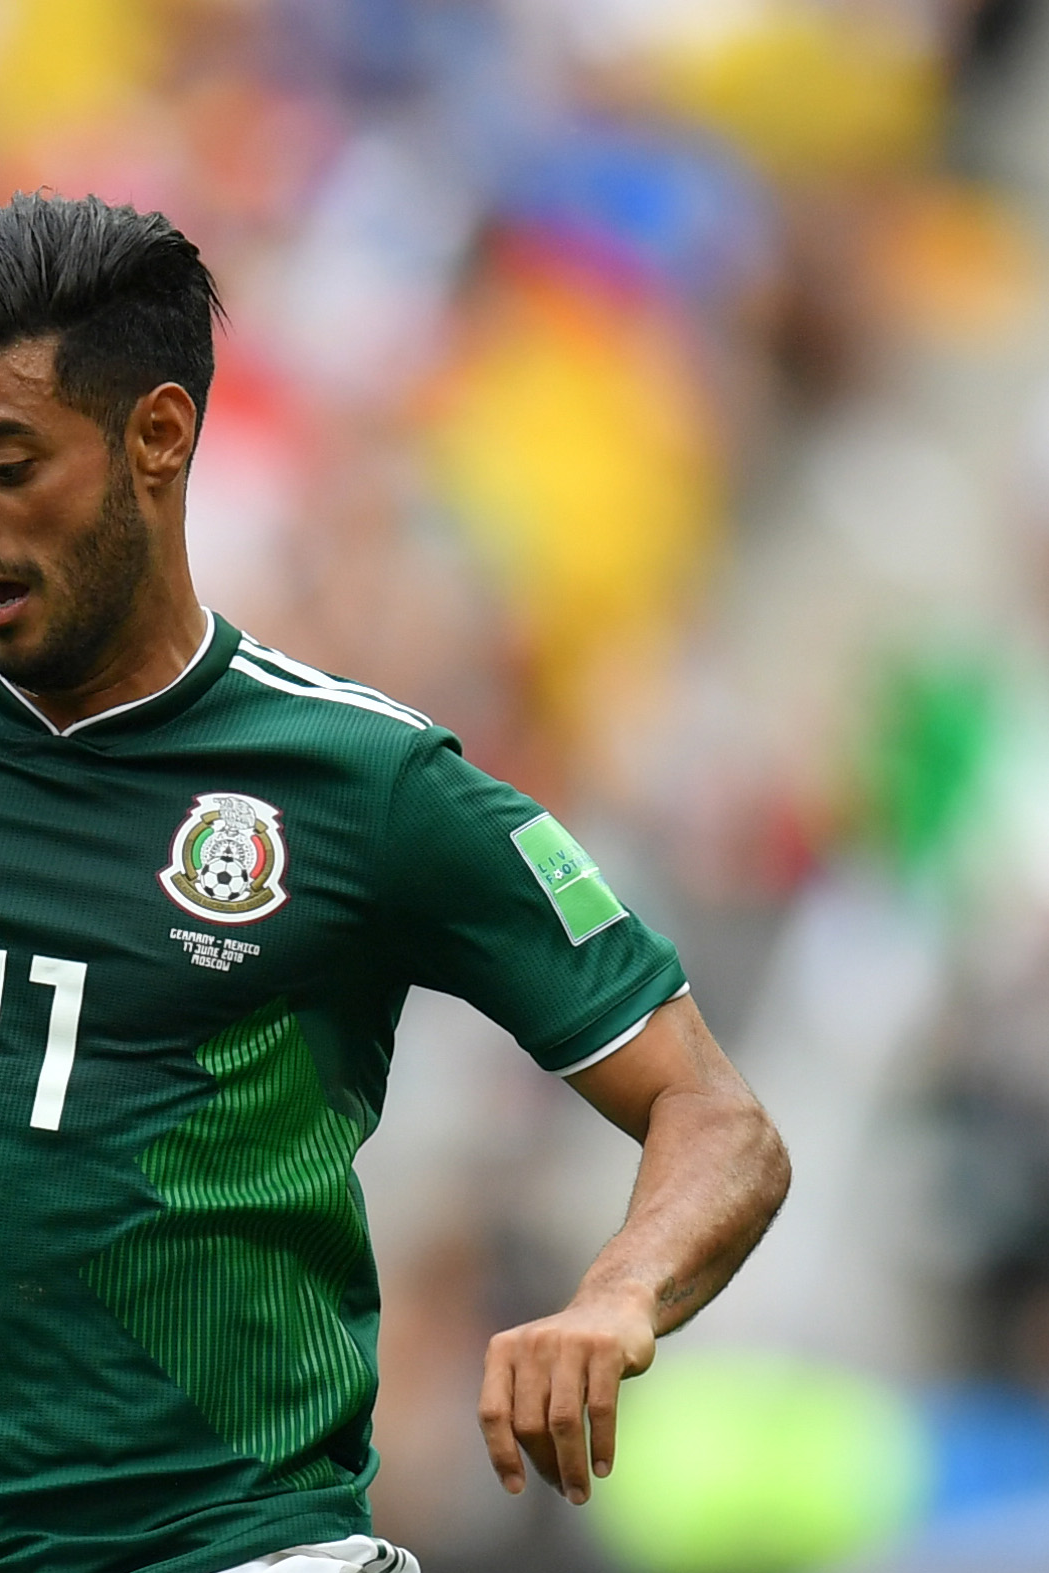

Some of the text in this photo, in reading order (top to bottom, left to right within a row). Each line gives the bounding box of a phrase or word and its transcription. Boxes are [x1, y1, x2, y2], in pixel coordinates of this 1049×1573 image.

[183, 941, 243, 963] 17 JUNE 2018
[223, 939, 260, 956] MEXICO
[191, 953, 230, 972] MOSCOW
